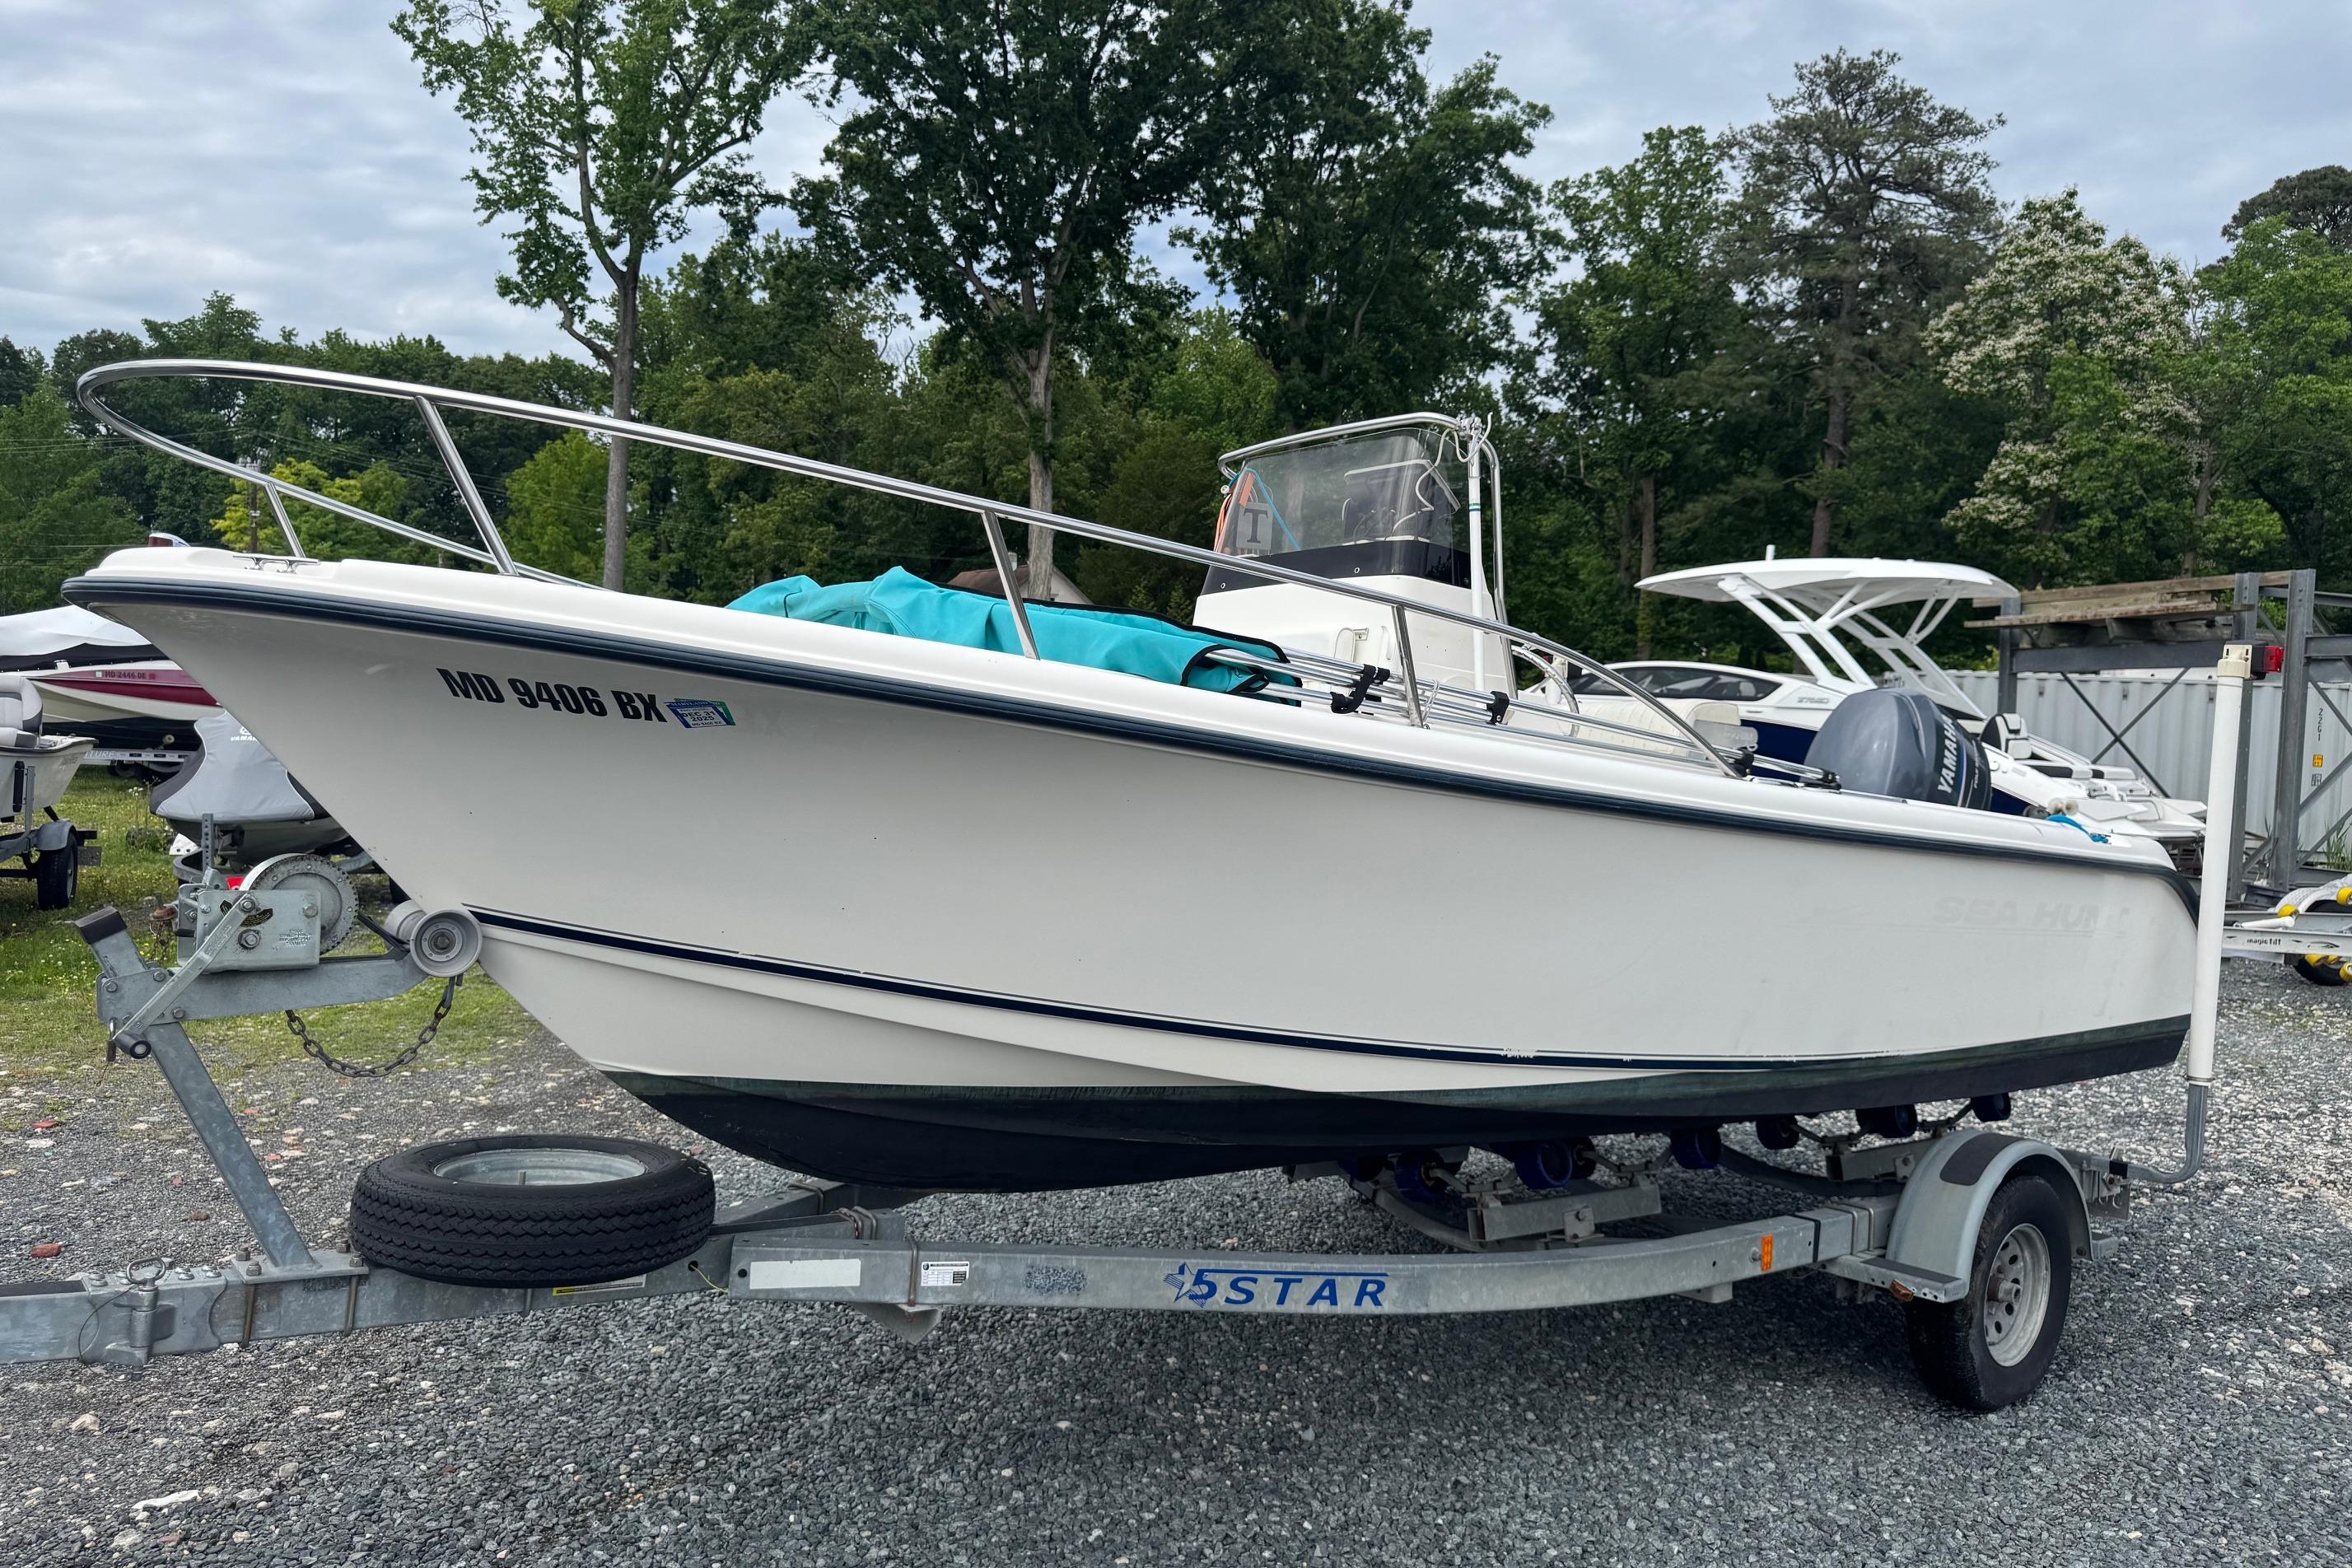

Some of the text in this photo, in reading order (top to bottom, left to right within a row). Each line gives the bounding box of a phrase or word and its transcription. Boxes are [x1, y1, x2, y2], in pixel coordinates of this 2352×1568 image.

[436, 668, 668, 722] MD 9406 BX
[1937, 714, 1958, 793] YAMAHA
[1932, 896, 2018, 925] SEA
